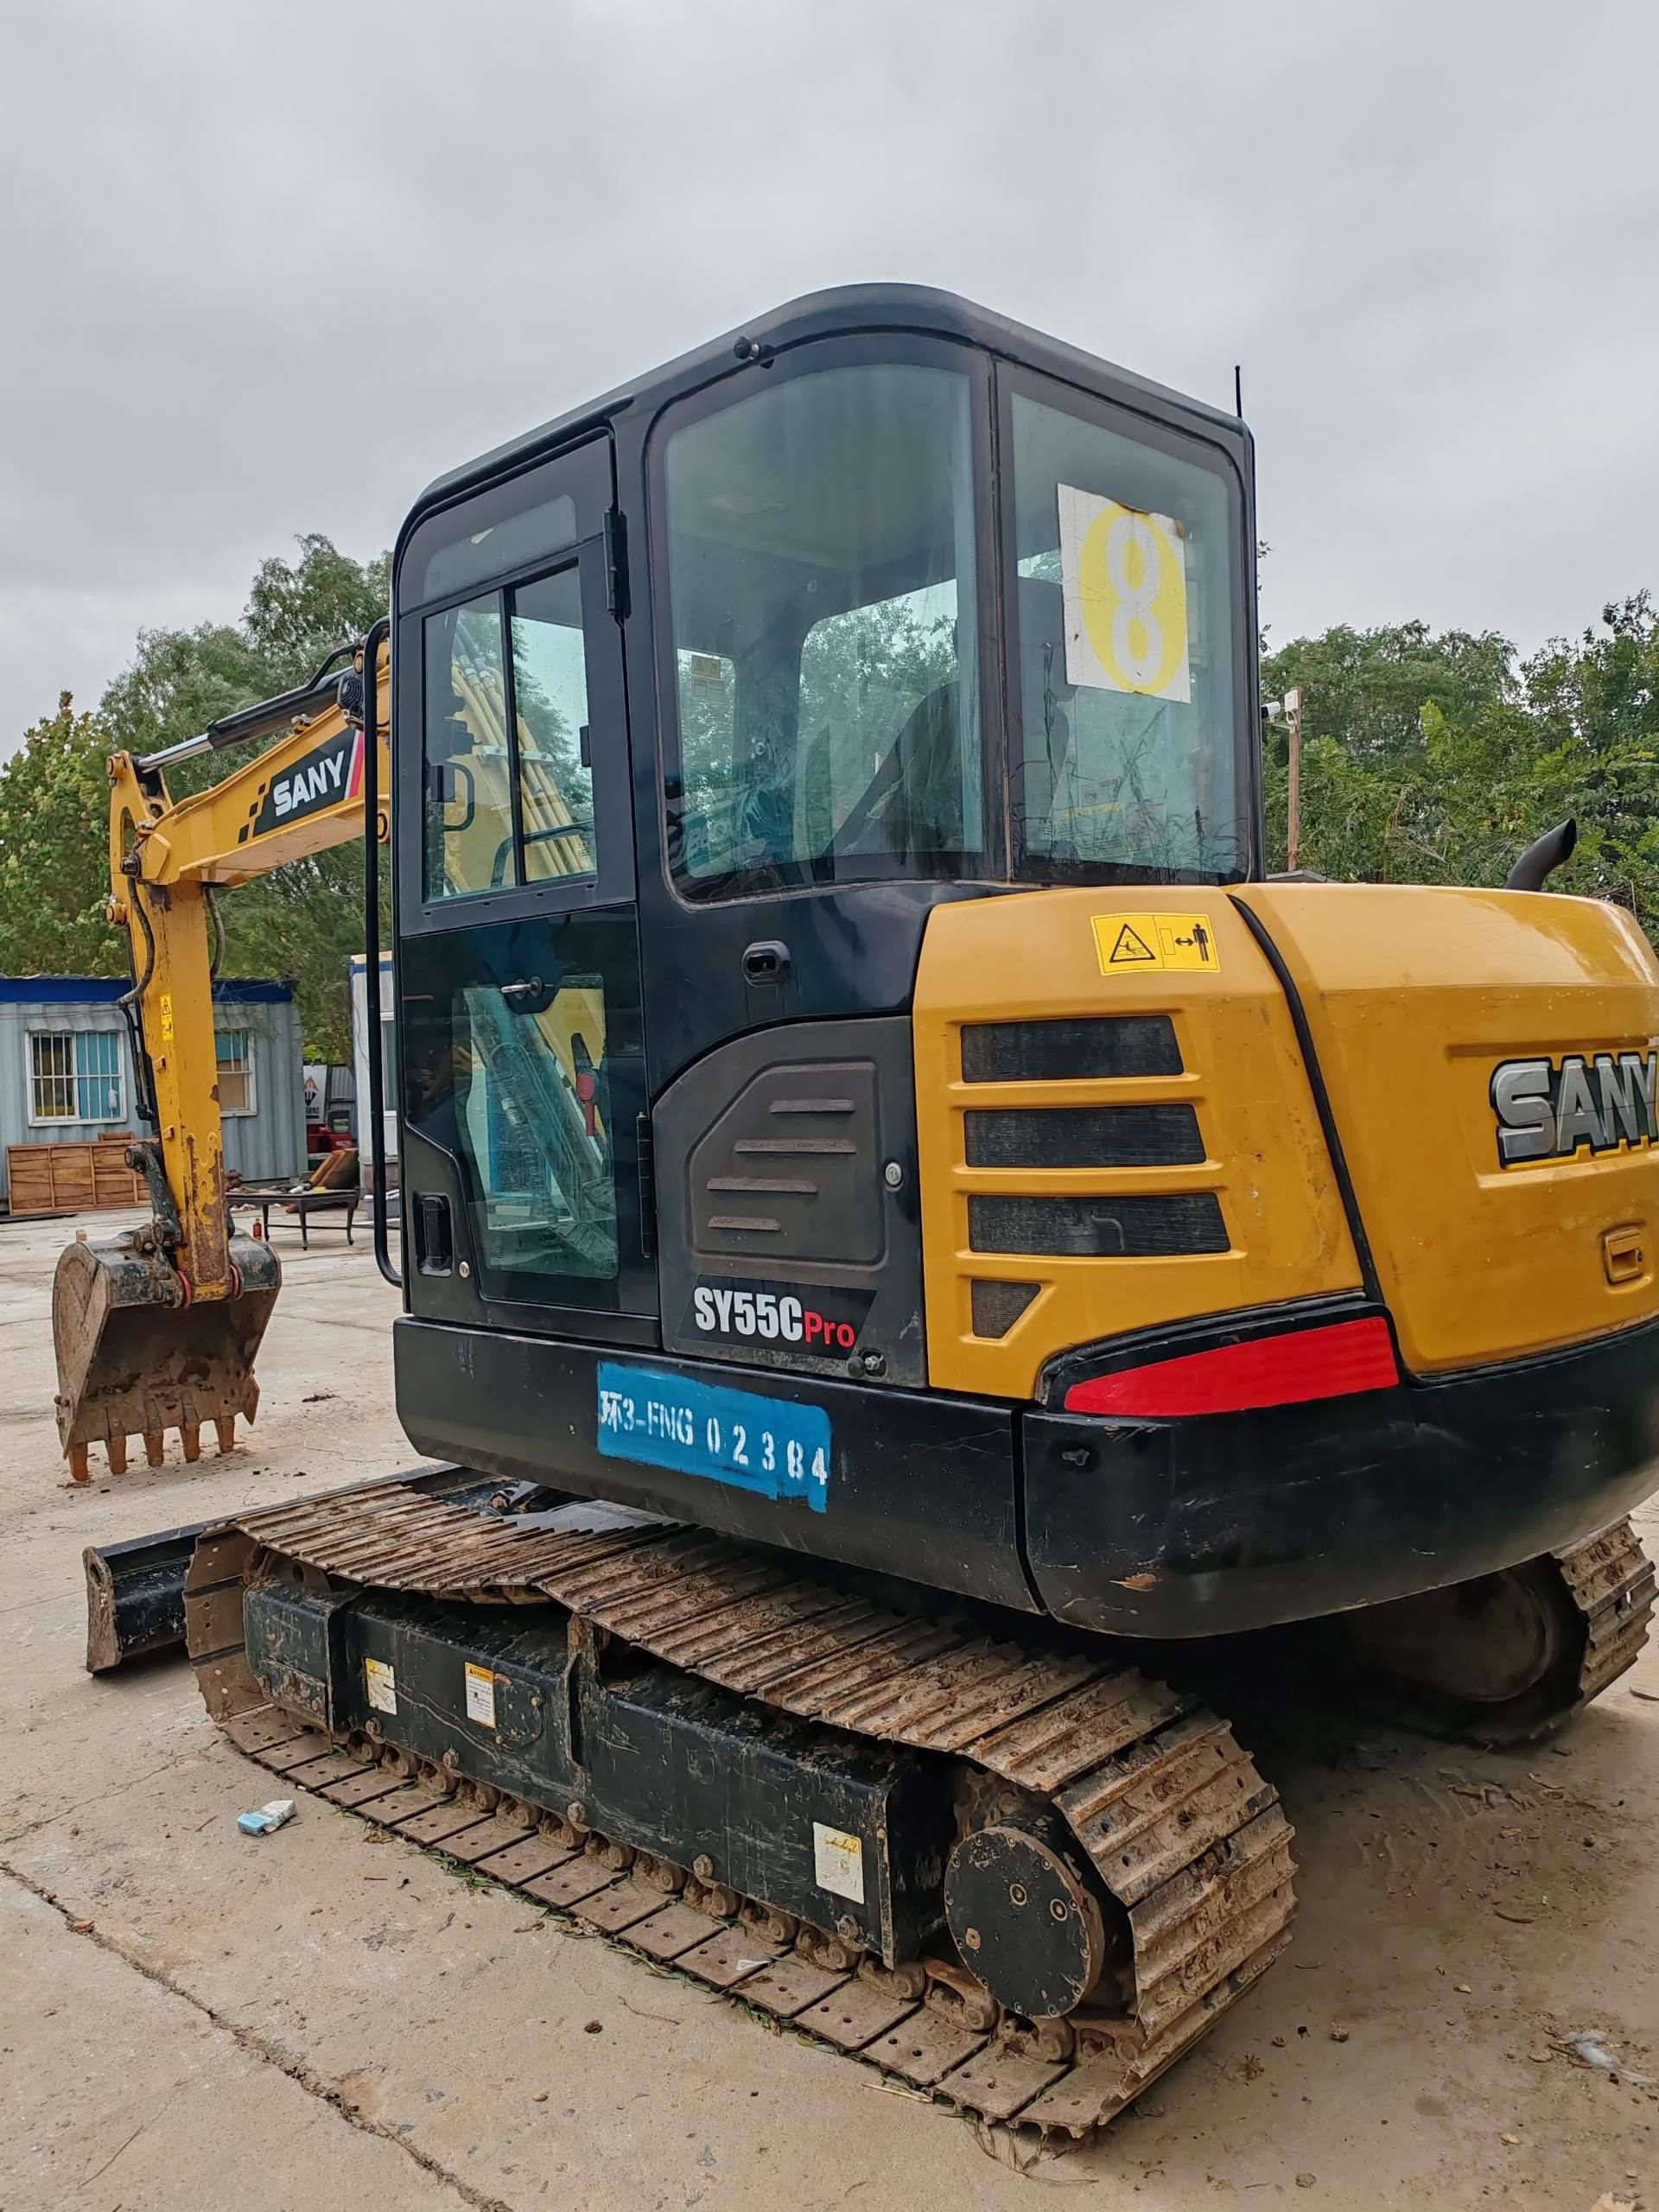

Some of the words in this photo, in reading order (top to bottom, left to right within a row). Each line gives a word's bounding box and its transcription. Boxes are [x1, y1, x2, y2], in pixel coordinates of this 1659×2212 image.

[1107, 513, 1163, 685] 8
[273, 749, 345, 817] SANY
[1491, 1053, 1657, 1160] SANY
